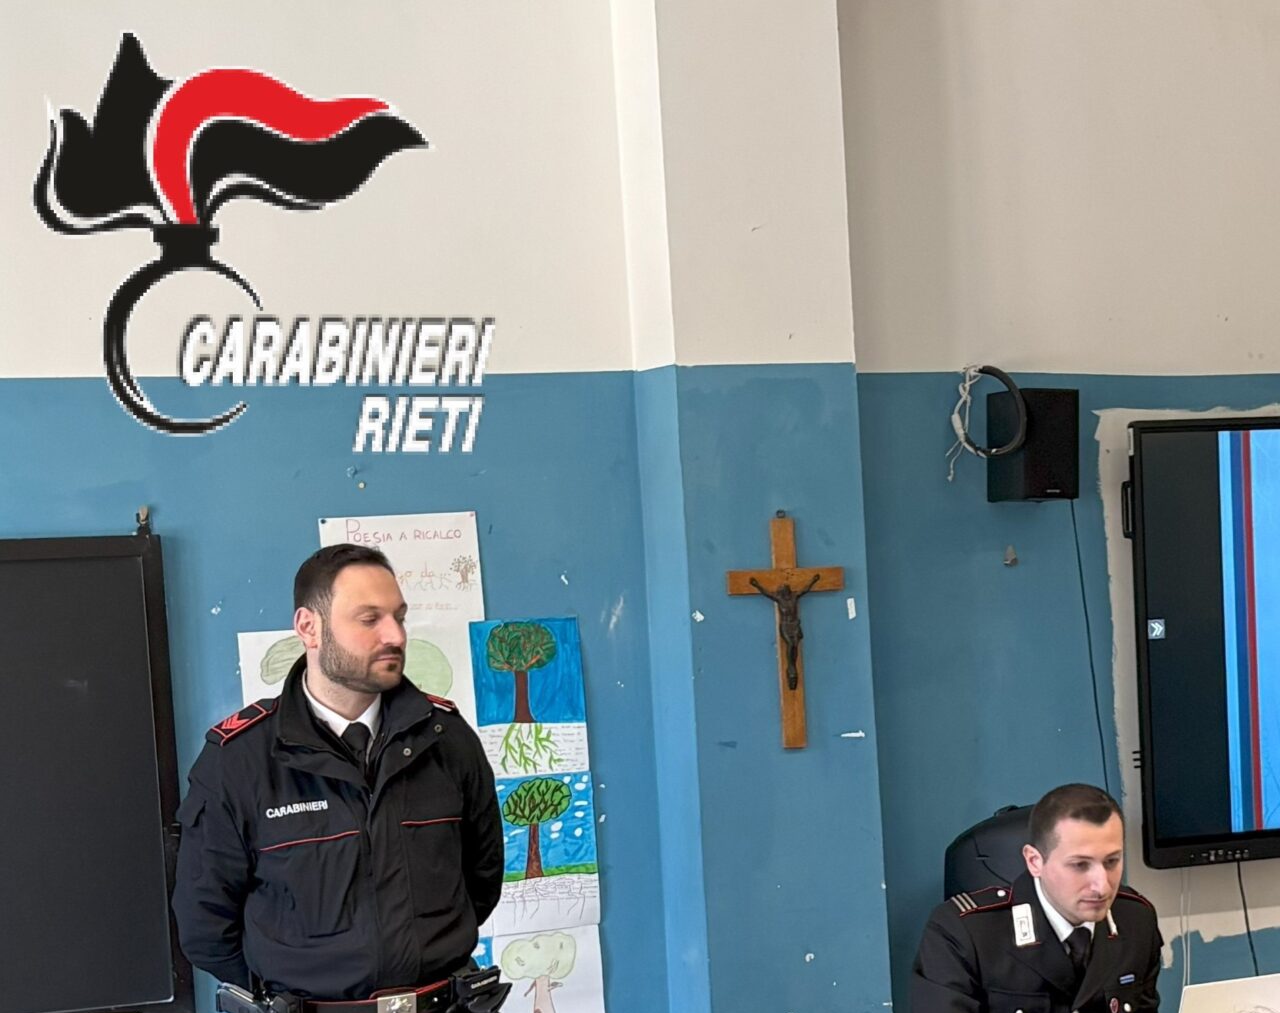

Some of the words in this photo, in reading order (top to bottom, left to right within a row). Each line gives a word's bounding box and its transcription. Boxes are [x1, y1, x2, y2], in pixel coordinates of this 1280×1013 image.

[346, 519, 392, 544] POESIA
[400, 531, 407, 541] A
[414, 529, 462, 540] RICALCO
[266, 800, 328, 818] CARABINIERI
